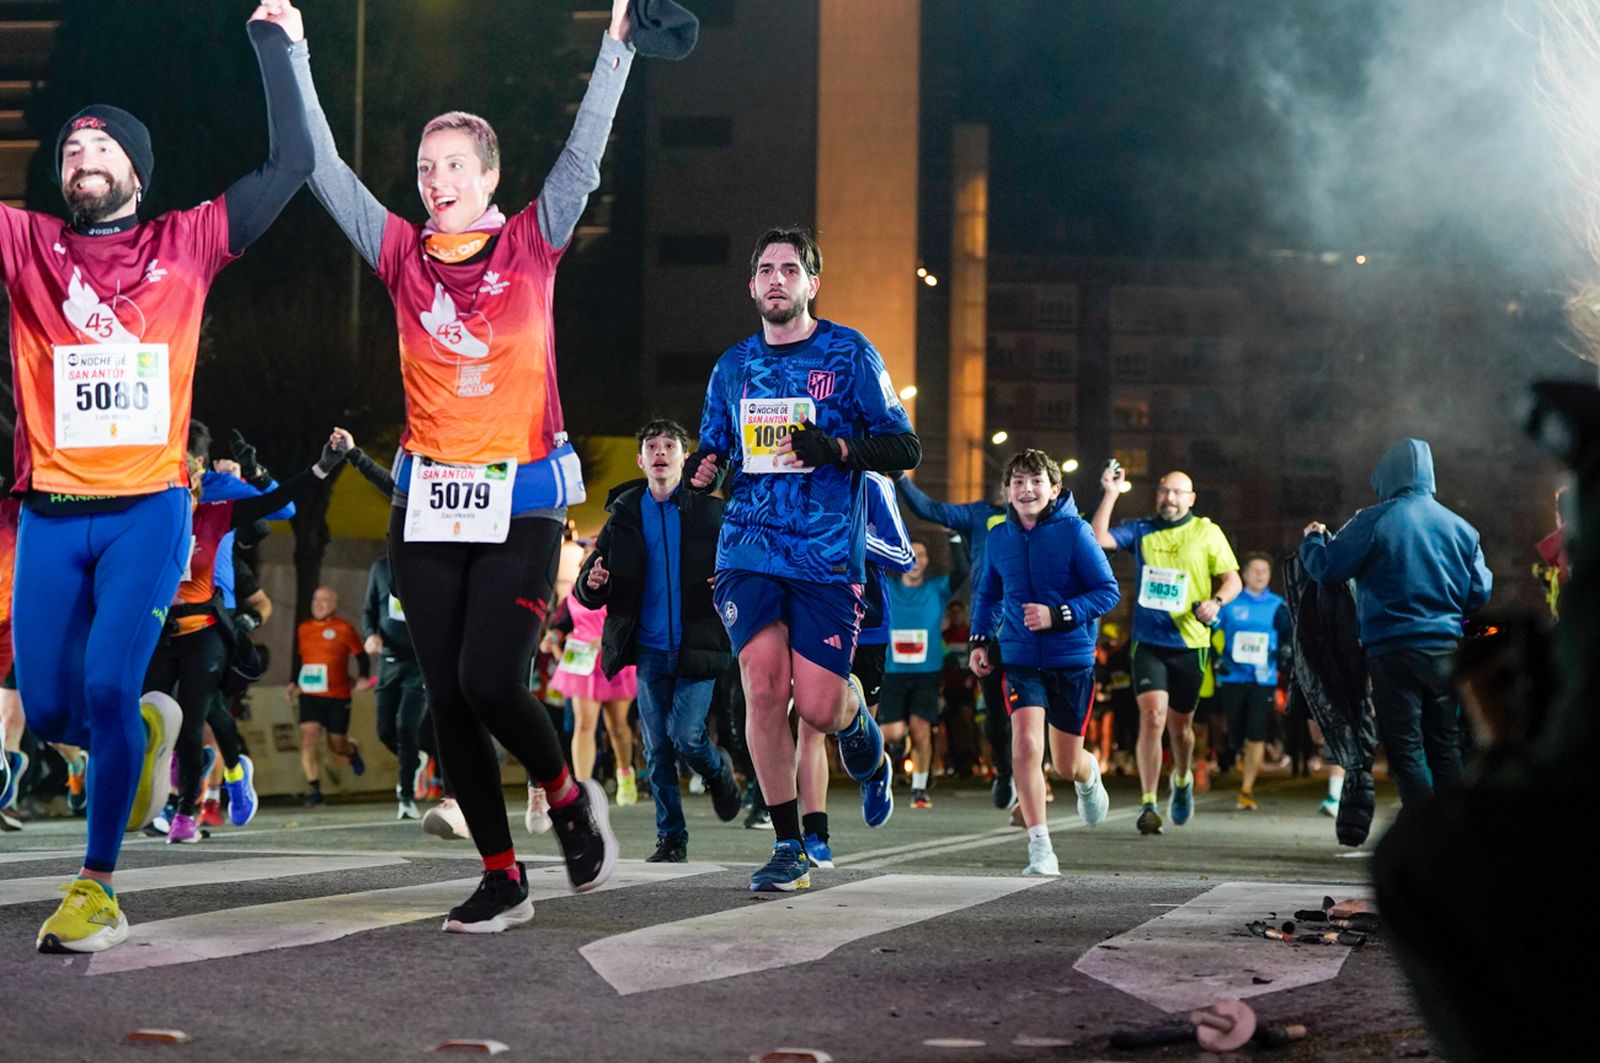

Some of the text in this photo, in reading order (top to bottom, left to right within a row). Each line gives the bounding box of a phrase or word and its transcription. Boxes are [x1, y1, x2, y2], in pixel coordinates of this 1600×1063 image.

[85, 312, 114, 339] 43
[436, 323, 463, 345] 43
[80, 356, 112, 367] NOCHE
[68, 370, 90, 381] SAN
[76, 381, 150, 412] 5080
[756, 406, 779, 414] NOCHE
[780, 406, 789, 414] DE
[747, 416, 763, 425] SAN
[422, 469, 440, 480] SAN
[430, 482, 492, 510] 5079
[1149, 582, 1179, 598] 5035
